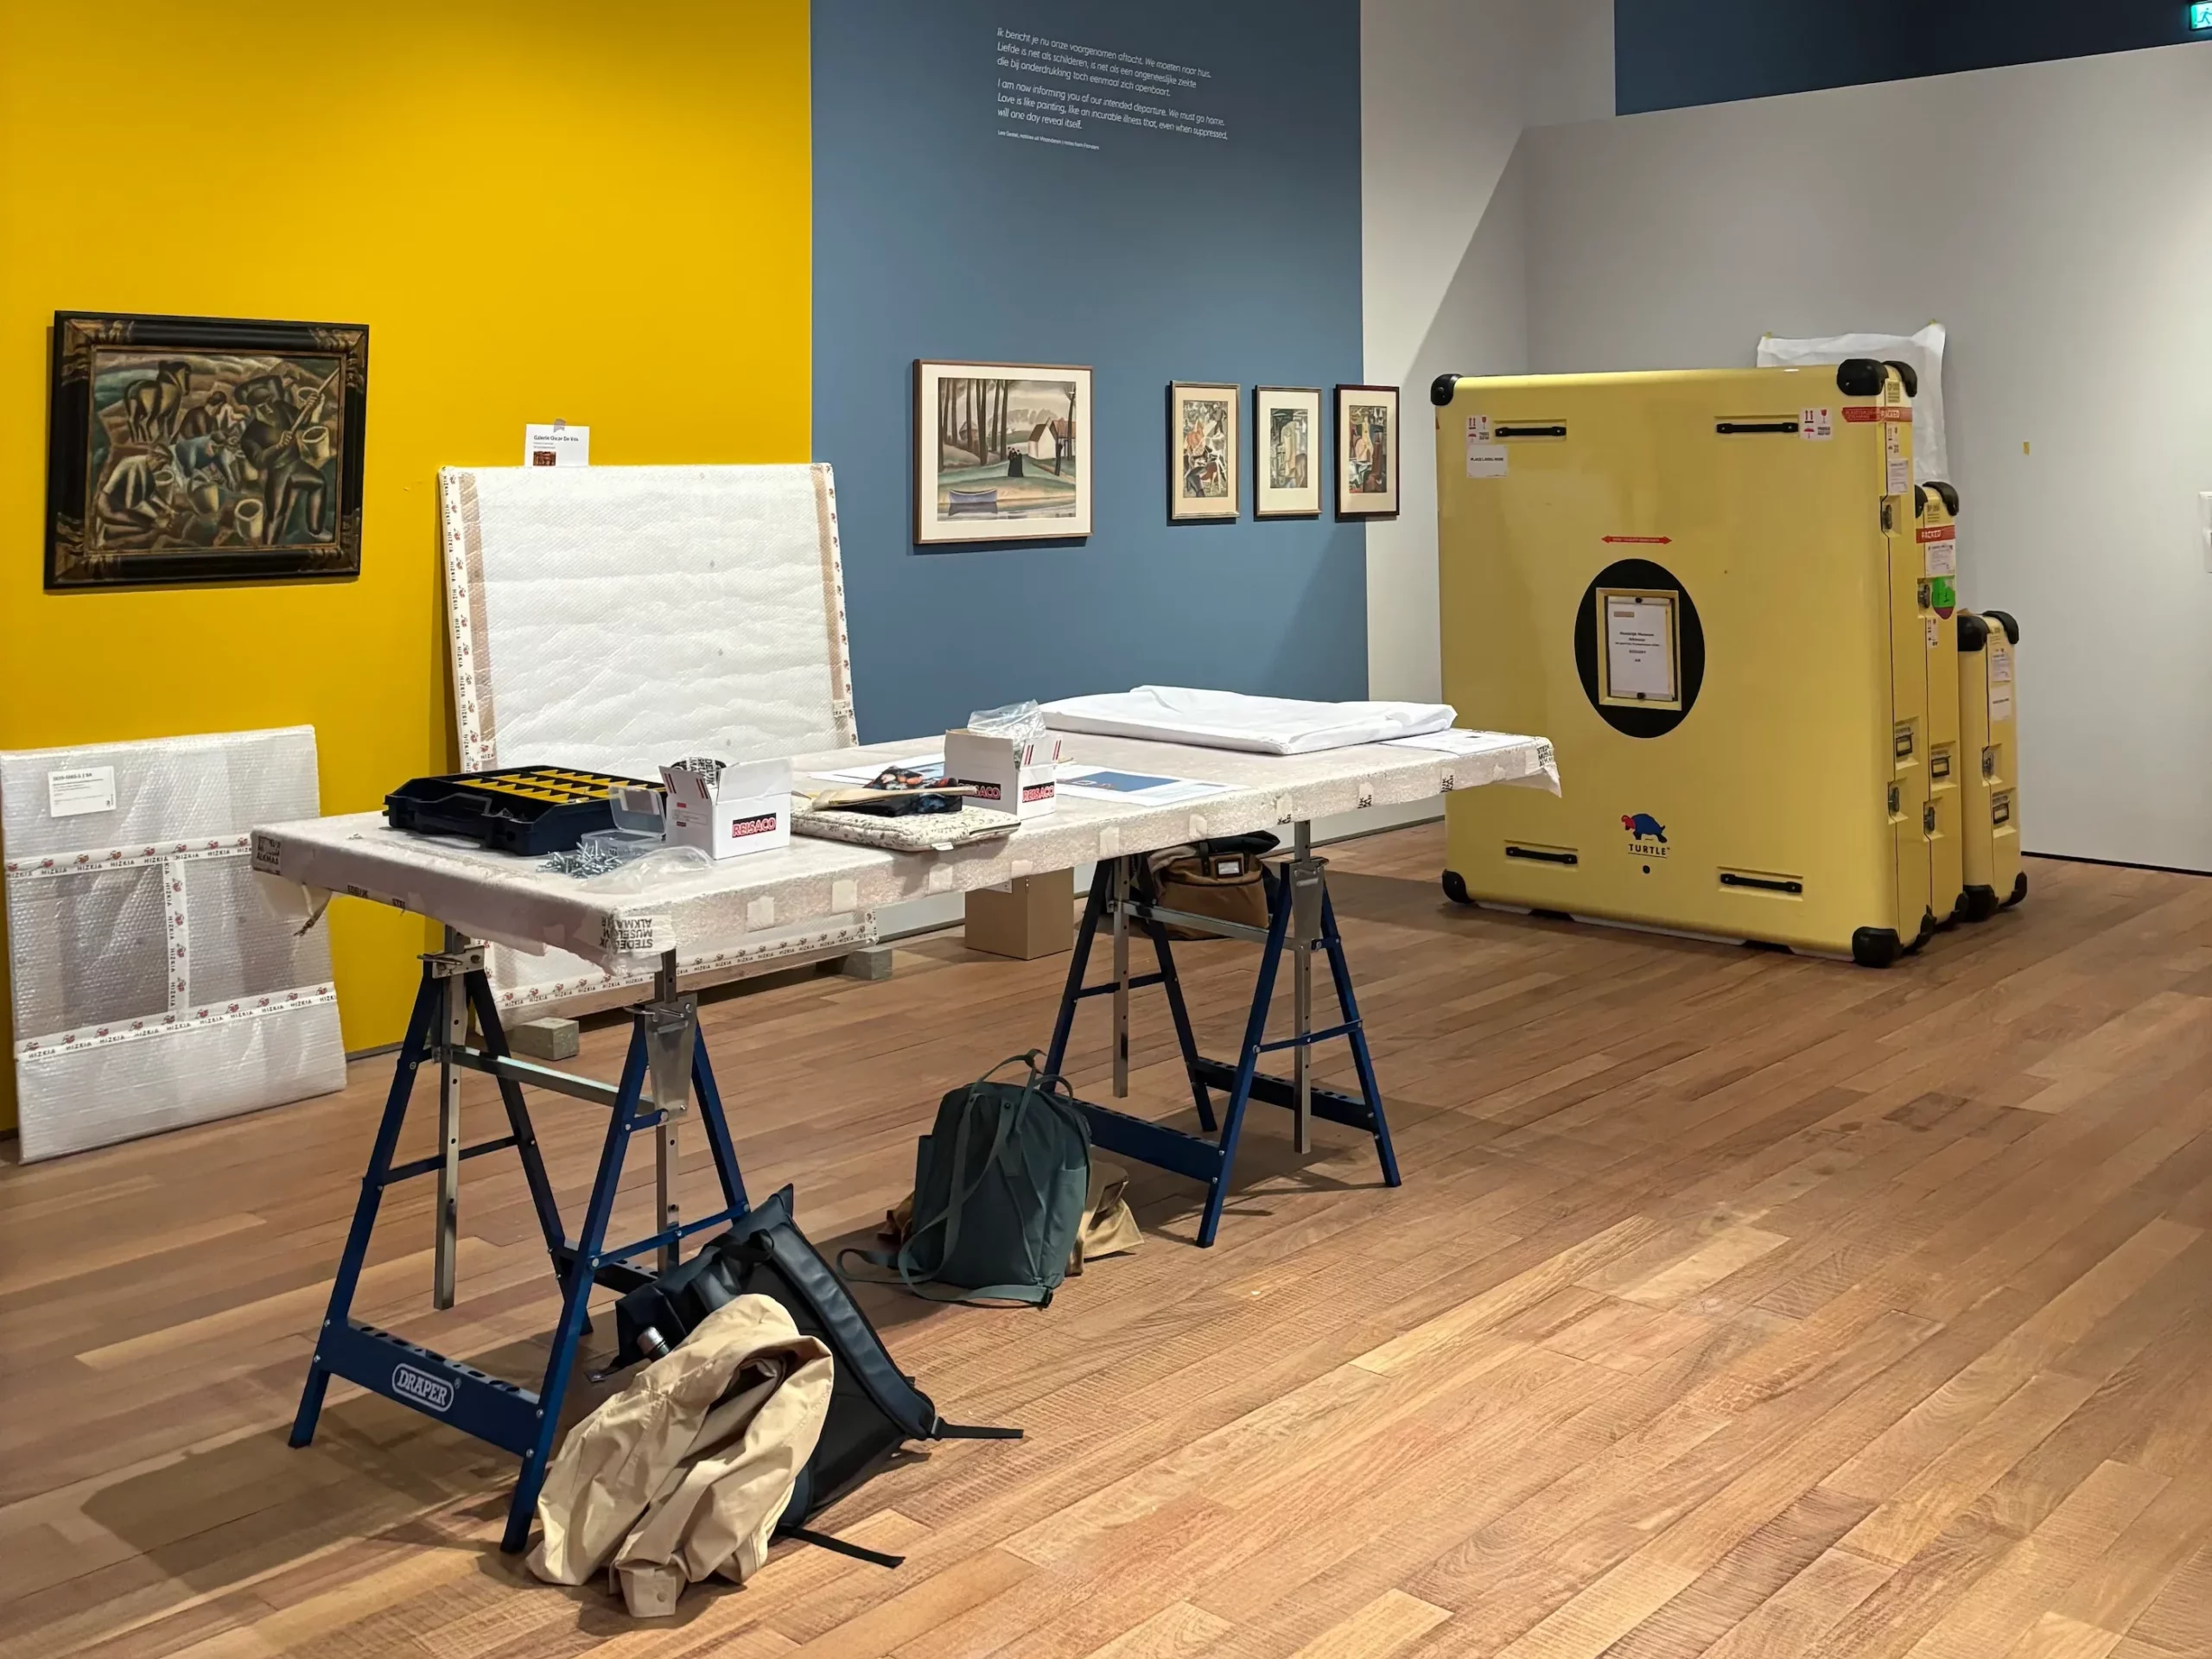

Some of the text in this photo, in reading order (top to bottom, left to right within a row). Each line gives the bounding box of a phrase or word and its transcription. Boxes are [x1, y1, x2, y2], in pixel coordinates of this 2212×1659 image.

[997, 28, 1211, 78] Ik bericht je nu onze voorgenomen aftocht. We moeten naar huis.
[997, 41, 1020, 54] Liefde
[1028, 49, 1040, 59] net
[1042, 52, 1052, 60] als
[1053, 54, 1089, 69] schilderen,
[1109, 65, 1119, 74] als
[1120, 67, 1134, 76] een
[1135, 71, 1177, 85] ongeneeslijke
[1178, 79, 1197, 88] ziekte
[997, 56, 1171, 97] die bij onderdrukking toch eenmaal zich openbaart.
[997, 78, 1225, 126] I am now informing you of our intended departure. We must go home.
[997, 92, 1015, 104] Love
[1016, 97, 1022, 105] is
[1023, 97, 1036, 107] like
[1068, 105, 1080, 115] like
[1091, 110, 1122, 123] incurable
[1123, 114, 1142, 126] illness
[1158, 122, 1175, 130] even
[1175, 124, 1192, 134] when
[997, 107, 1083, 130] will one day reveal itself.
[958, 783, 1001, 799] SACO
[1023, 785, 1054, 802] REISACO
[733, 817, 776, 838] REISACO
[110, 859, 135, 868] HIZKIA
[143, 855, 169, 864] HIZKIA
[1628, 843, 1666, 855] TURTLE
[505, 999, 524, 1007] HIZKIA
[577, 985, 596, 994] HIZKIA
[626, 976, 643, 985] HIZKIA
[29, 1049, 55, 1059] HIZKIA
[66, 1041, 92, 1051] HIZKIA
[99, 1035, 124, 1044] HIZKIA
[134, 1028, 159, 1037] HIZKIA
[200, 1016, 224, 1025] HIZKIA
[261, 1004, 284, 1013] HIZKIA
[290, 999, 312, 1007] HIZKIA
[397, 1370, 448, 1406] DRAPER
